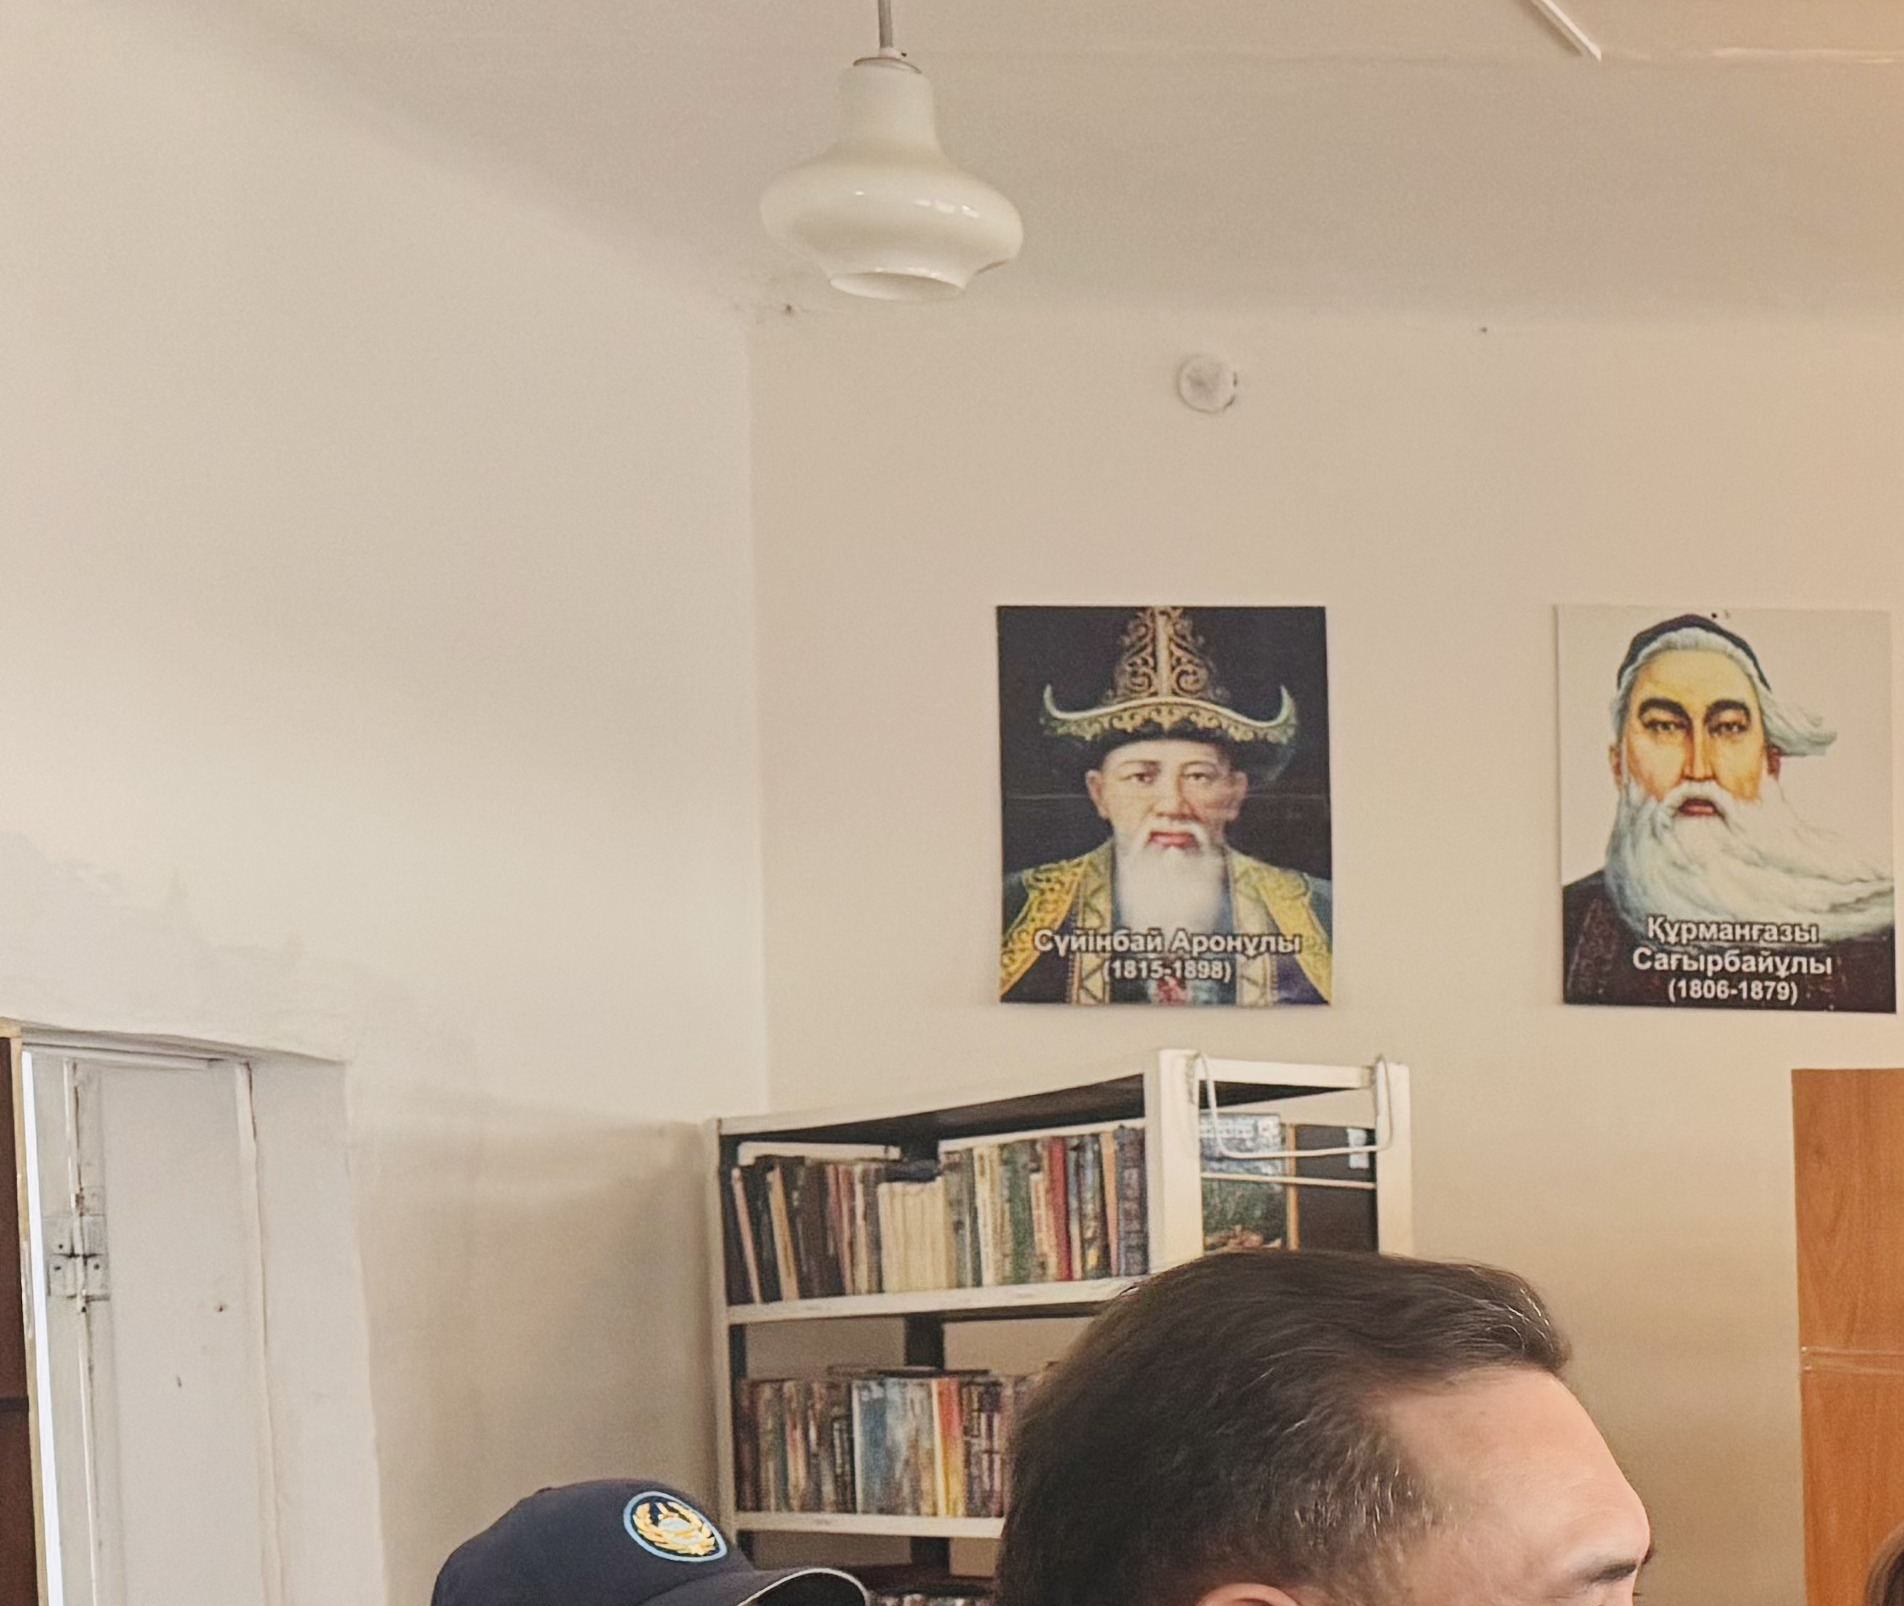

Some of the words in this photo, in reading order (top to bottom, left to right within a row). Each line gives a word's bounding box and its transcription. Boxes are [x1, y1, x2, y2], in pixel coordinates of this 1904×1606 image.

[1033, 928, 1162, 956] Сүйінбай
[1171, 931, 1301, 957] Аронұлы
[1647, 917, 1819, 944] Құрманғазы
[1102, 959, 1232, 984] (1815-1898)
[1632, 948, 1833, 978] Сағырбайұлы
[1668, 979, 1799, 1004] (1806-1879)
